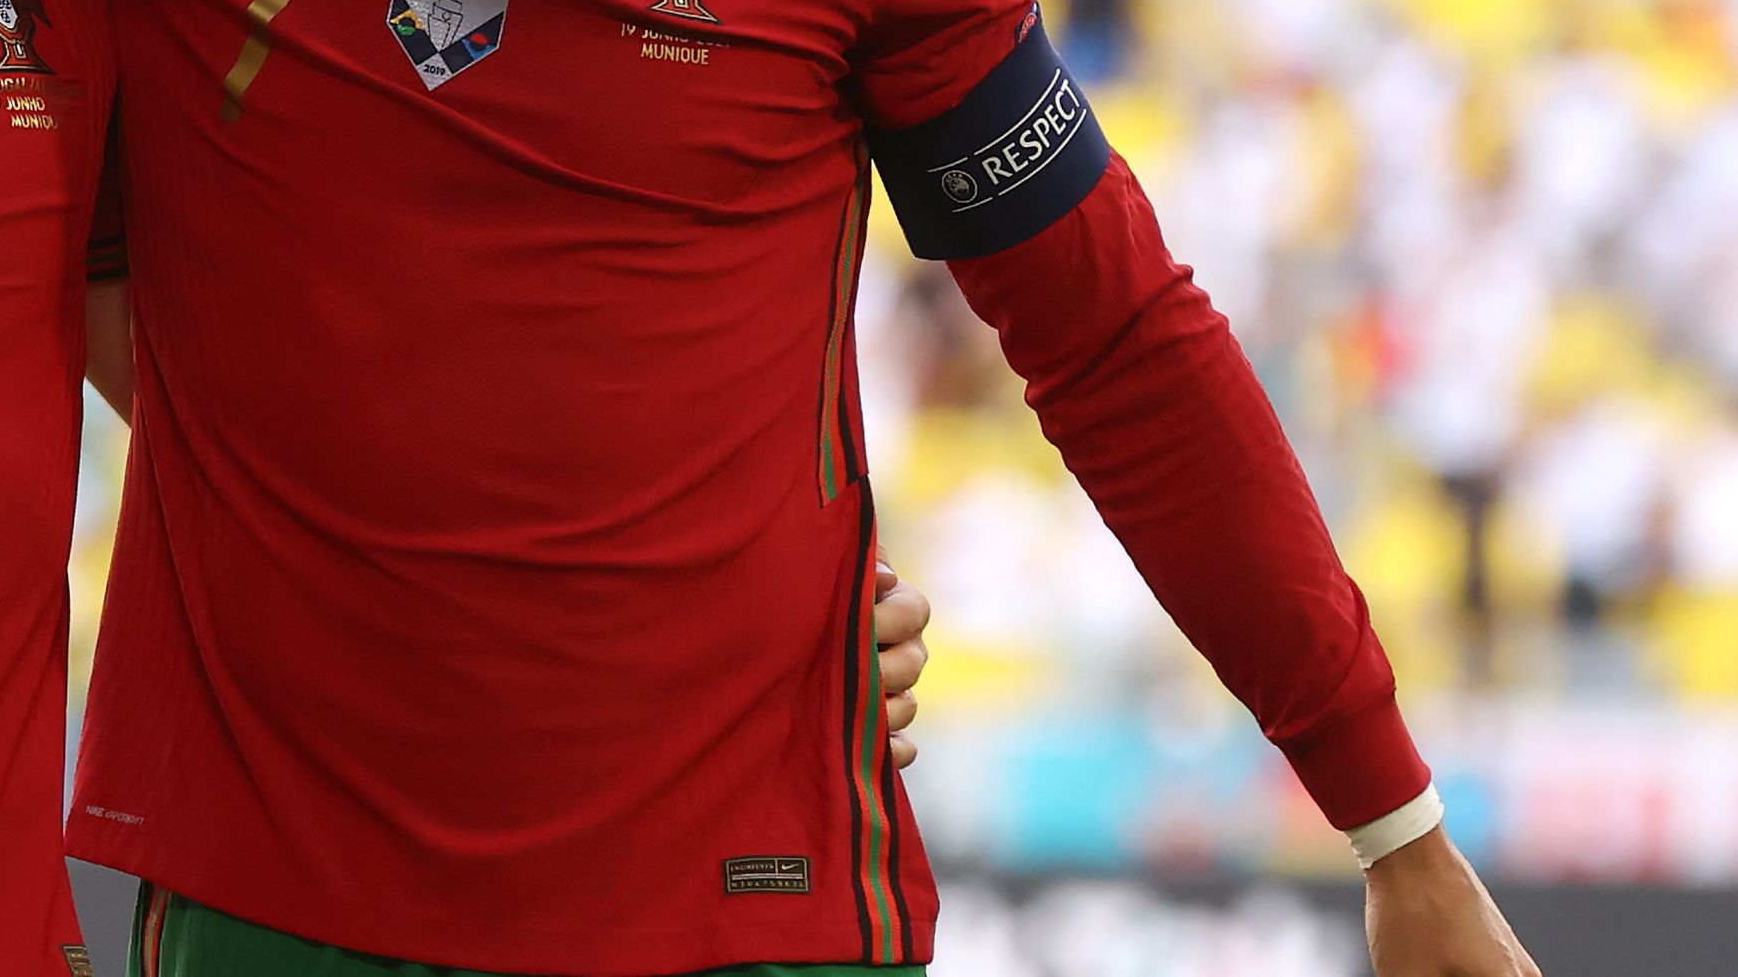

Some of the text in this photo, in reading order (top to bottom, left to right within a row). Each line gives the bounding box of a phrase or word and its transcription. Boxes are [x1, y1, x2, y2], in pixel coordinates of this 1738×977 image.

[640, 43, 710, 65] MUNIQUE
[423, 64, 446, 76] 2019
[6, 95, 46, 112] JUNHO
[11, 114, 58, 131] MUNIQU
[981, 78, 1081, 185] RESPECT
